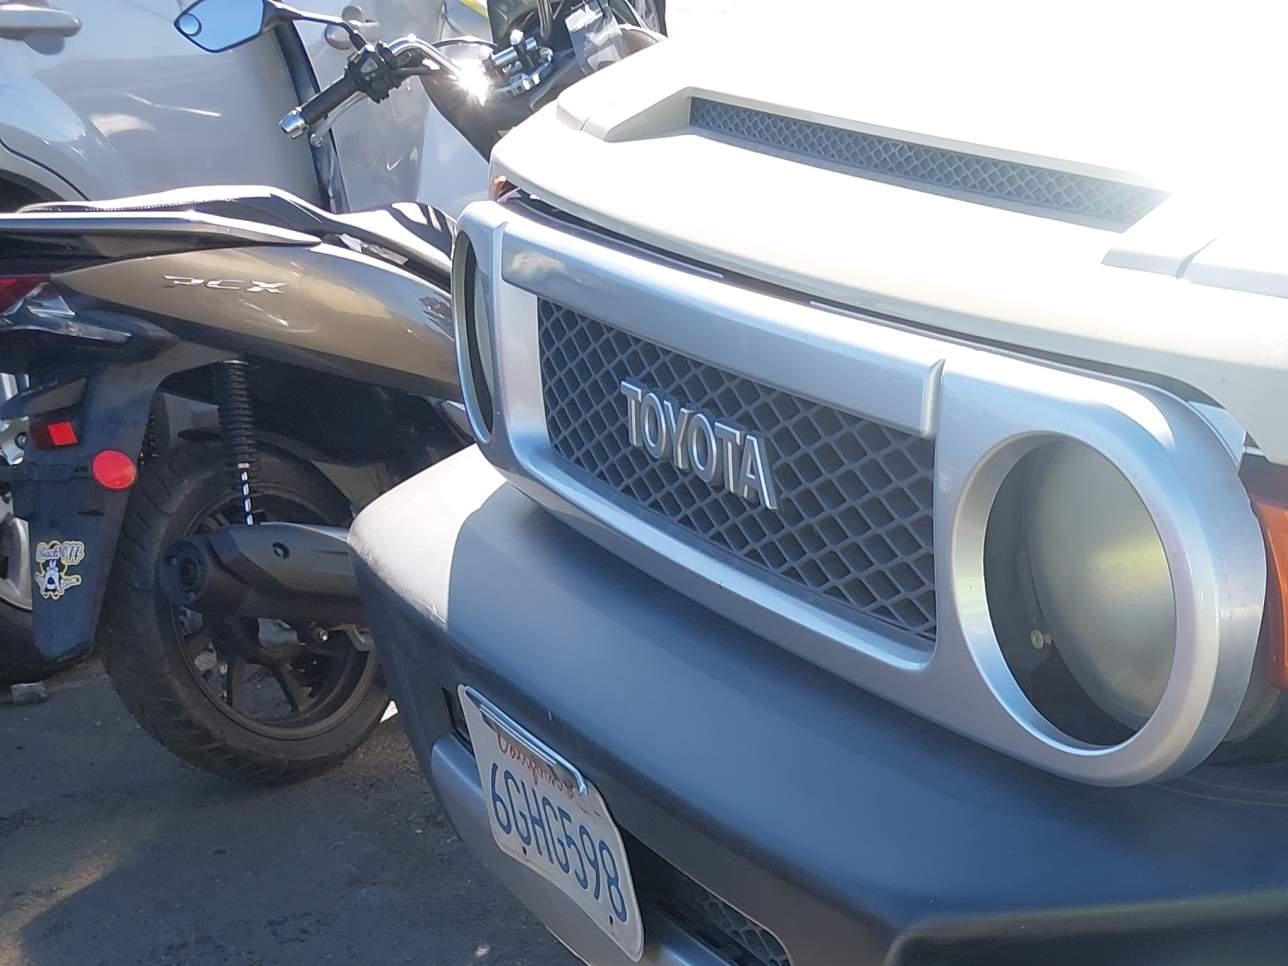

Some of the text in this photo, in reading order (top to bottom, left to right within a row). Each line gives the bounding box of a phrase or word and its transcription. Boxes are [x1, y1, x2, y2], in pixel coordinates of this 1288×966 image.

[162, 274, 288, 296] PCX
[620, 379, 778, 510] TOYOTA
[491, 763, 627, 922] 6GHG598
